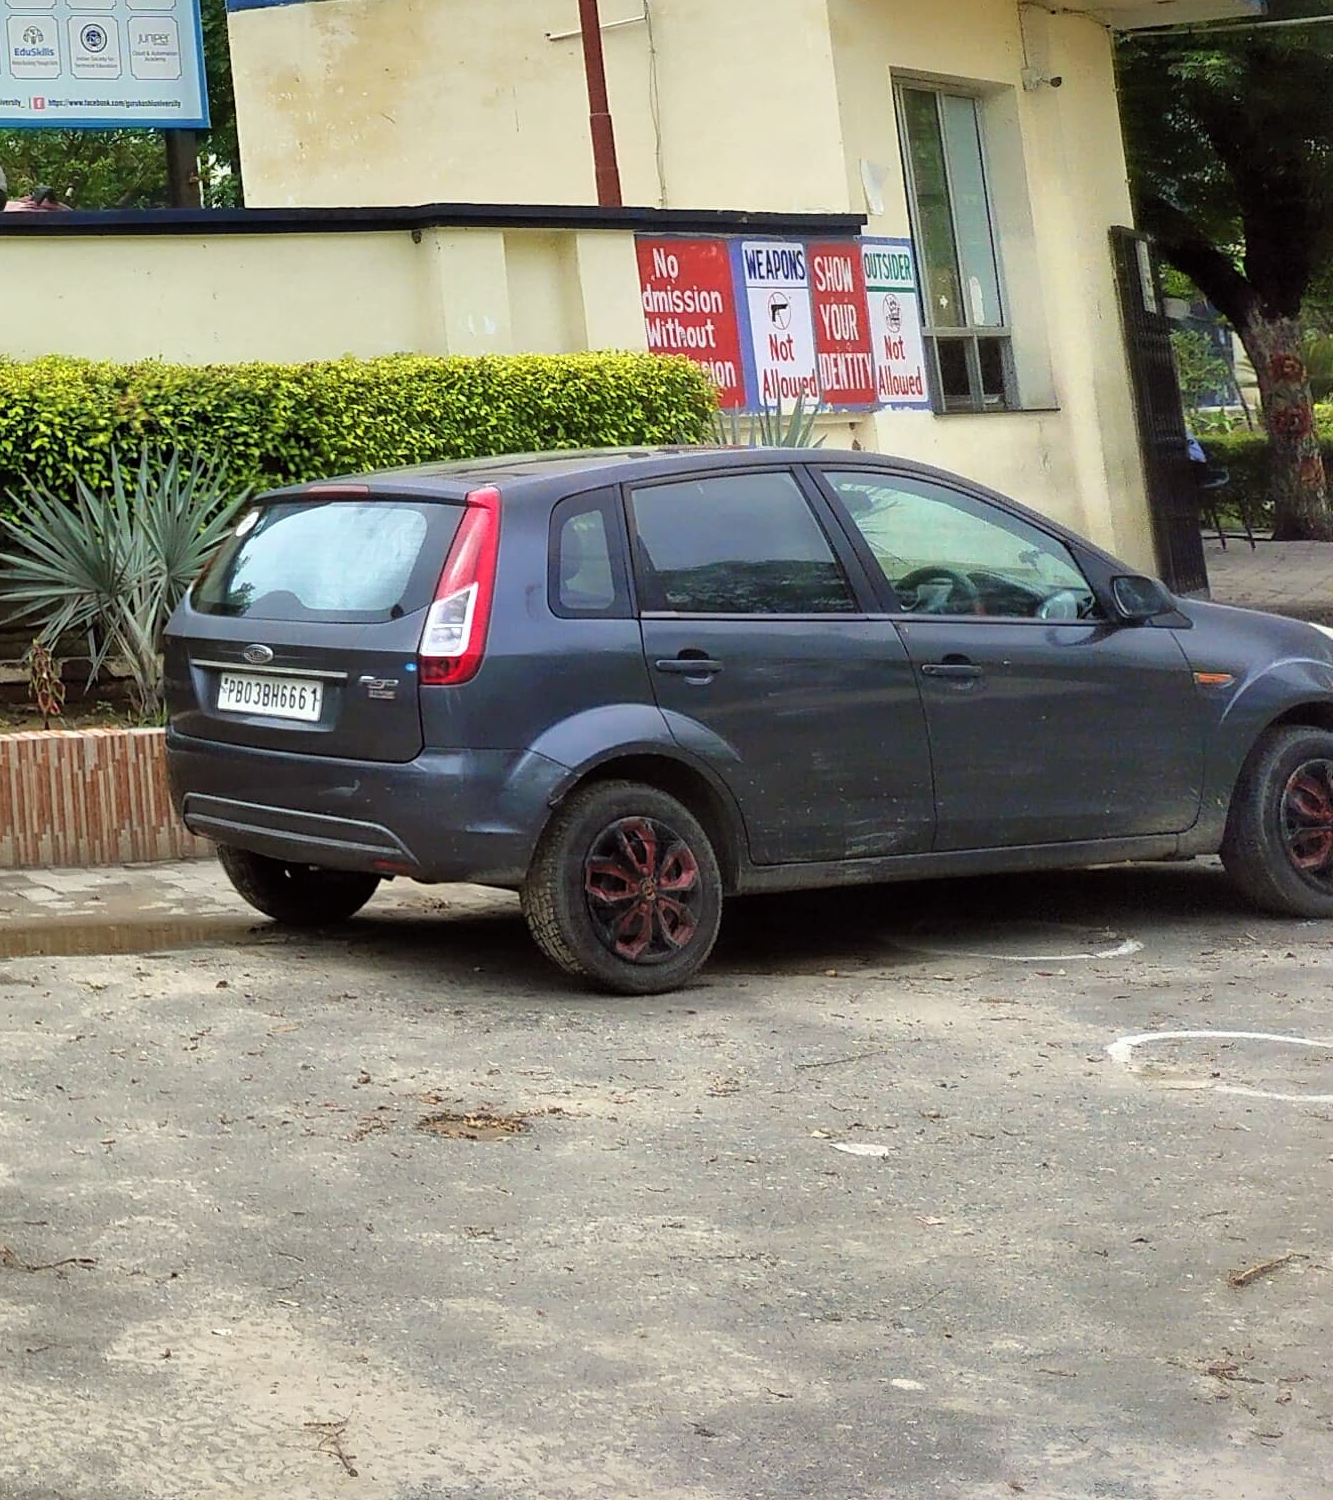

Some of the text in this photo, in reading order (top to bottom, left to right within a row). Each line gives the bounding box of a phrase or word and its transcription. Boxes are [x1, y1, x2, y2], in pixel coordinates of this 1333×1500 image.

[14, 47, 55, 56] EduSkills
[652, 248, 679, 279] No
[744, 250, 806, 280] WEAPONS
[813, 256, 854, 292] SHOW
[863, 253, 912, 281] OUTSIDER
[642, 283, 723, 313] dmission
[645, 318, 717, 348] Without
[819, 304, 859, 341] YOUR
[769, 334, 795, 362] Not
[884, 335, 906, 360] Not
[763, 369, 819, 399] Allowed
[818, 353, 875, 391] IDENTITY
[878, 366, 923, 396] Allowed
[227, 678, 318, 712] PB03BH6661
